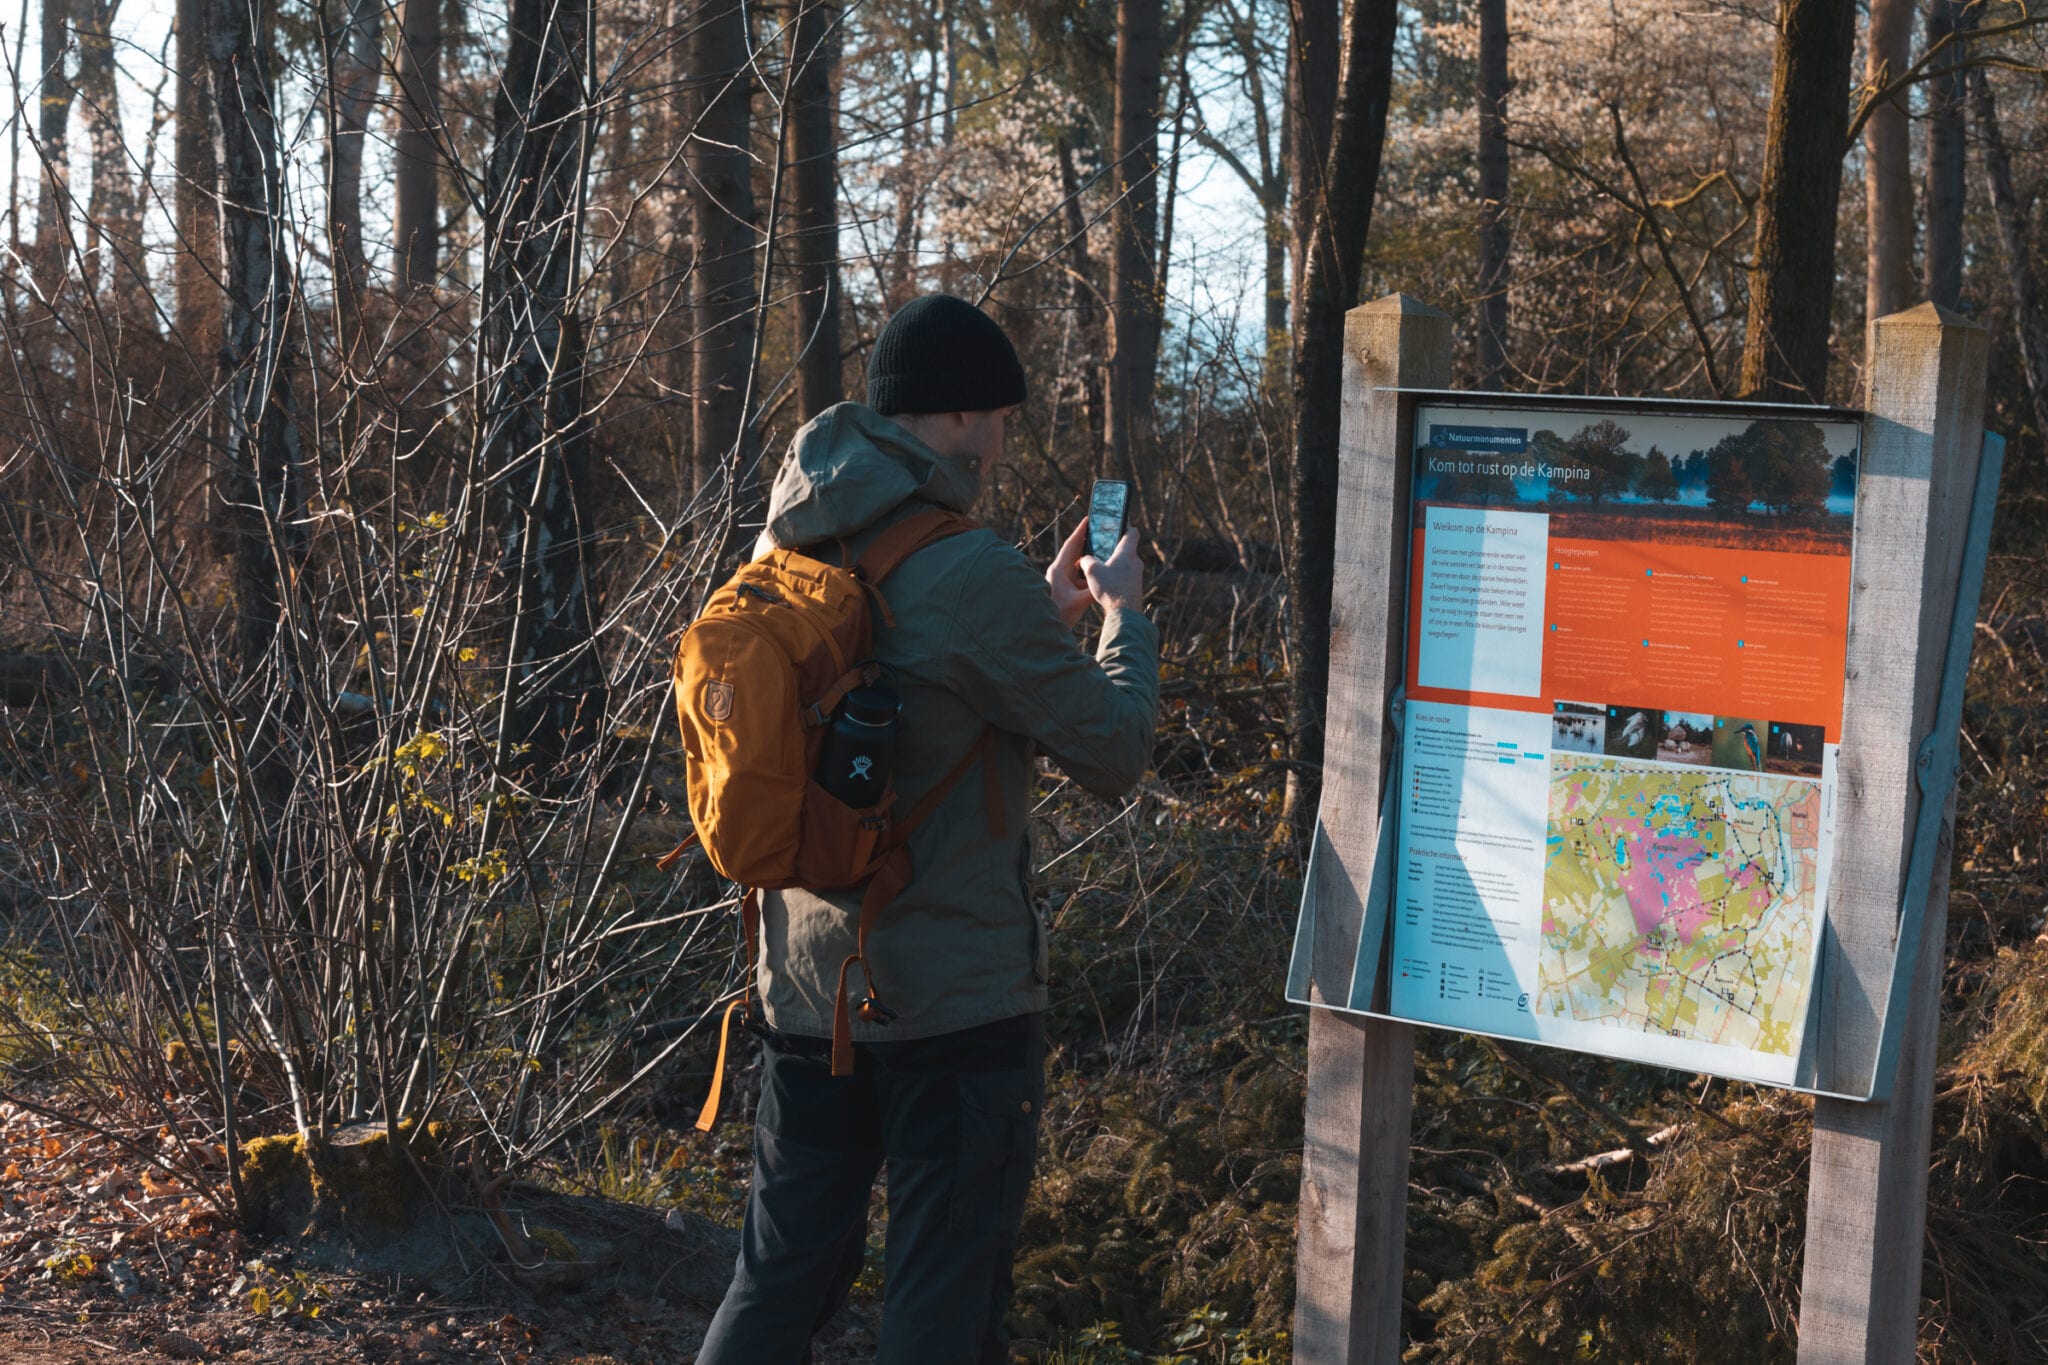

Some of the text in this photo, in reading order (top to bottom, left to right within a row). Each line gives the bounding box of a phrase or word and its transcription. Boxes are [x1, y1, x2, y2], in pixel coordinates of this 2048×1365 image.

[1448, 432, 1521, 445] Natuurmonumenten
[1428, 456, 1590, 482] Kom tot rust op de Kampina
[1433, 522, 1518, 538] Welkom op de Kampina
